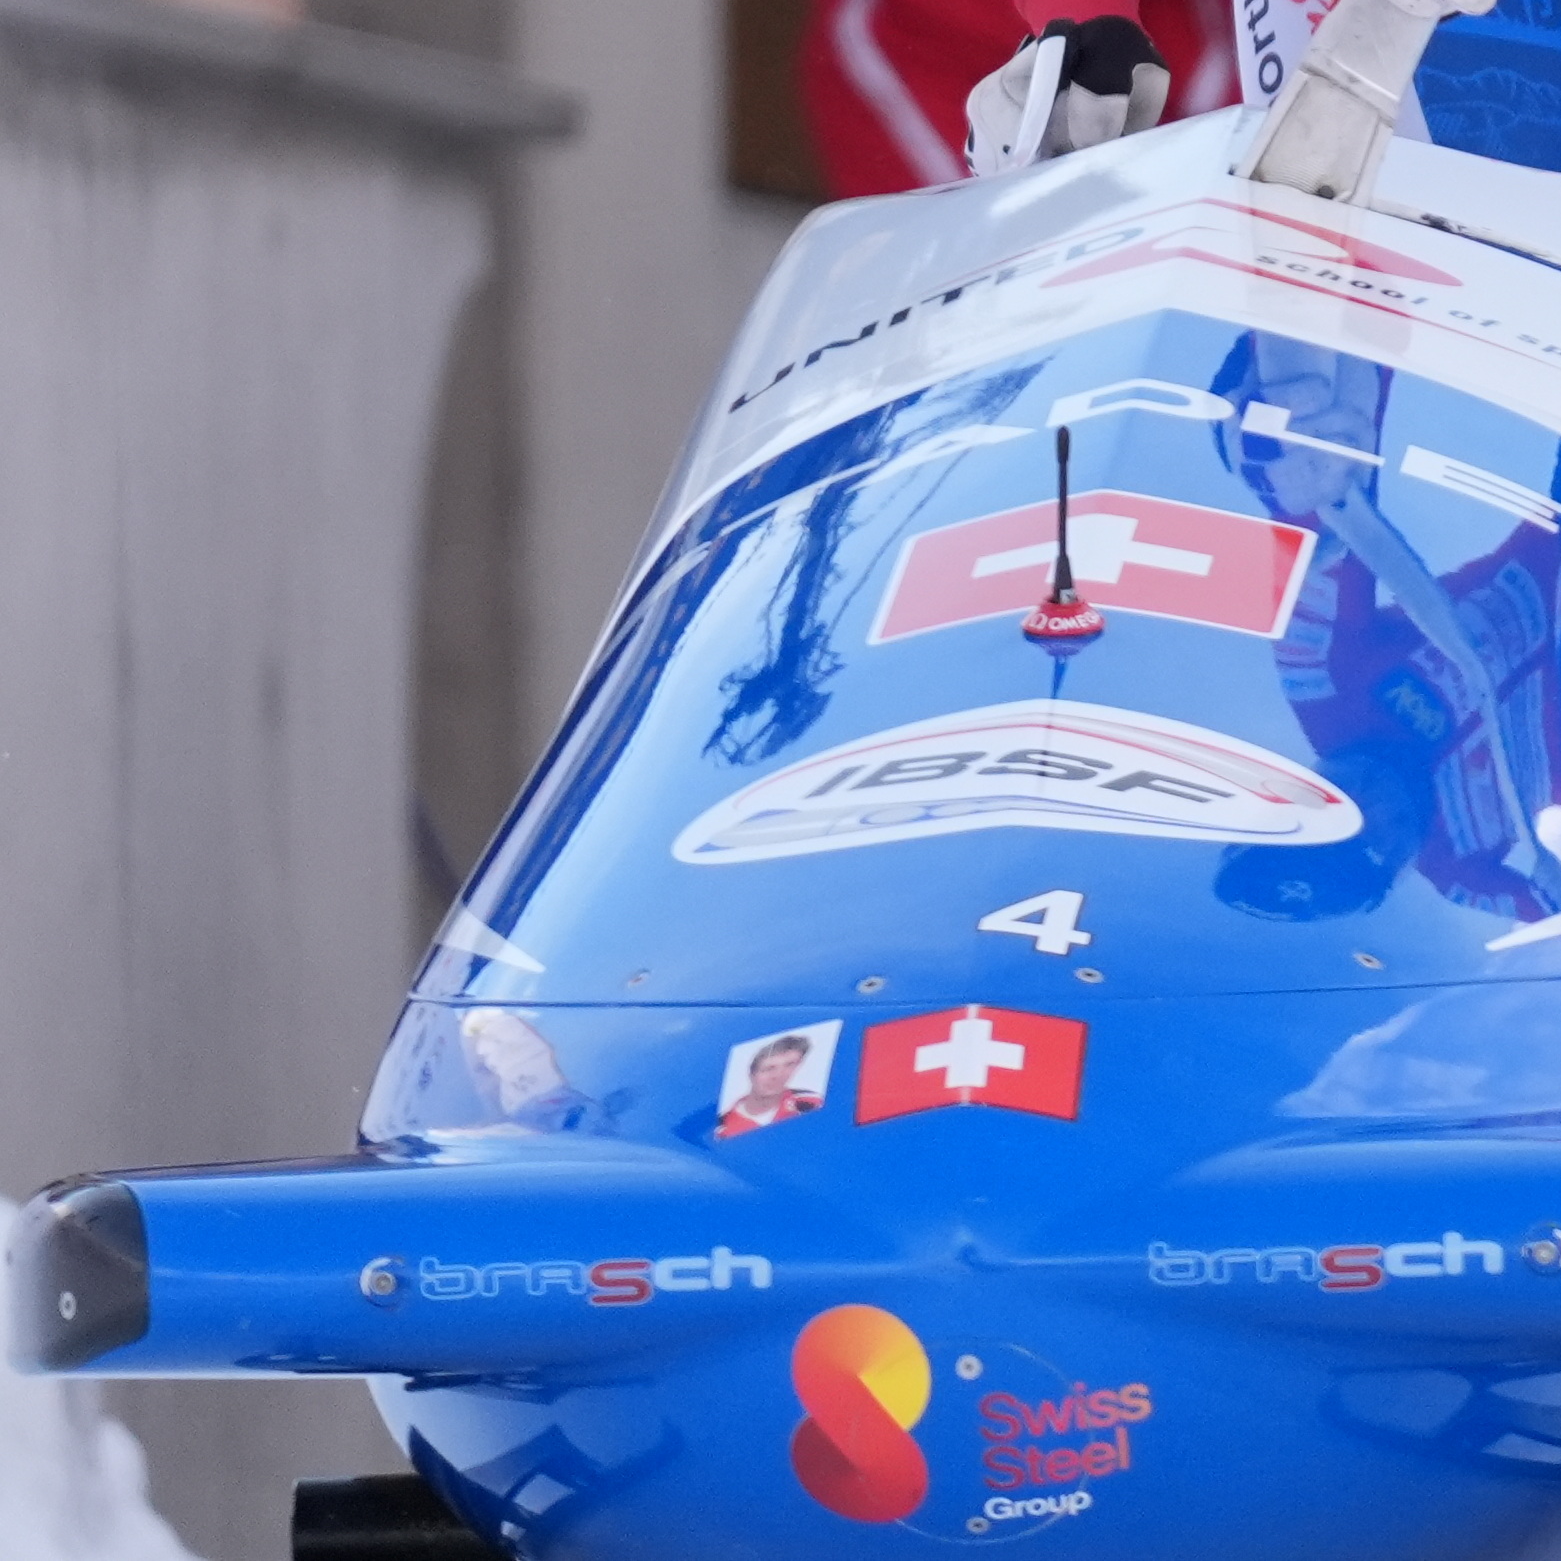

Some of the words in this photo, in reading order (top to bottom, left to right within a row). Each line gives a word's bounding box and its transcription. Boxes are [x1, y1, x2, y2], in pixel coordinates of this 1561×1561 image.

[728, 226, 1146, 414] UNITED
[1254, 252, 1429, 306] school
[1447, 308, 1502, 329] of
[804, 747, 1237, 806] IBSF
[976, 888, 1093, 956] 4
[977, 1381, 1153, 1444] Swiss
[981, 1426, 1131, 1492] Steel
[983, 1490, 1094, 1521] Group
